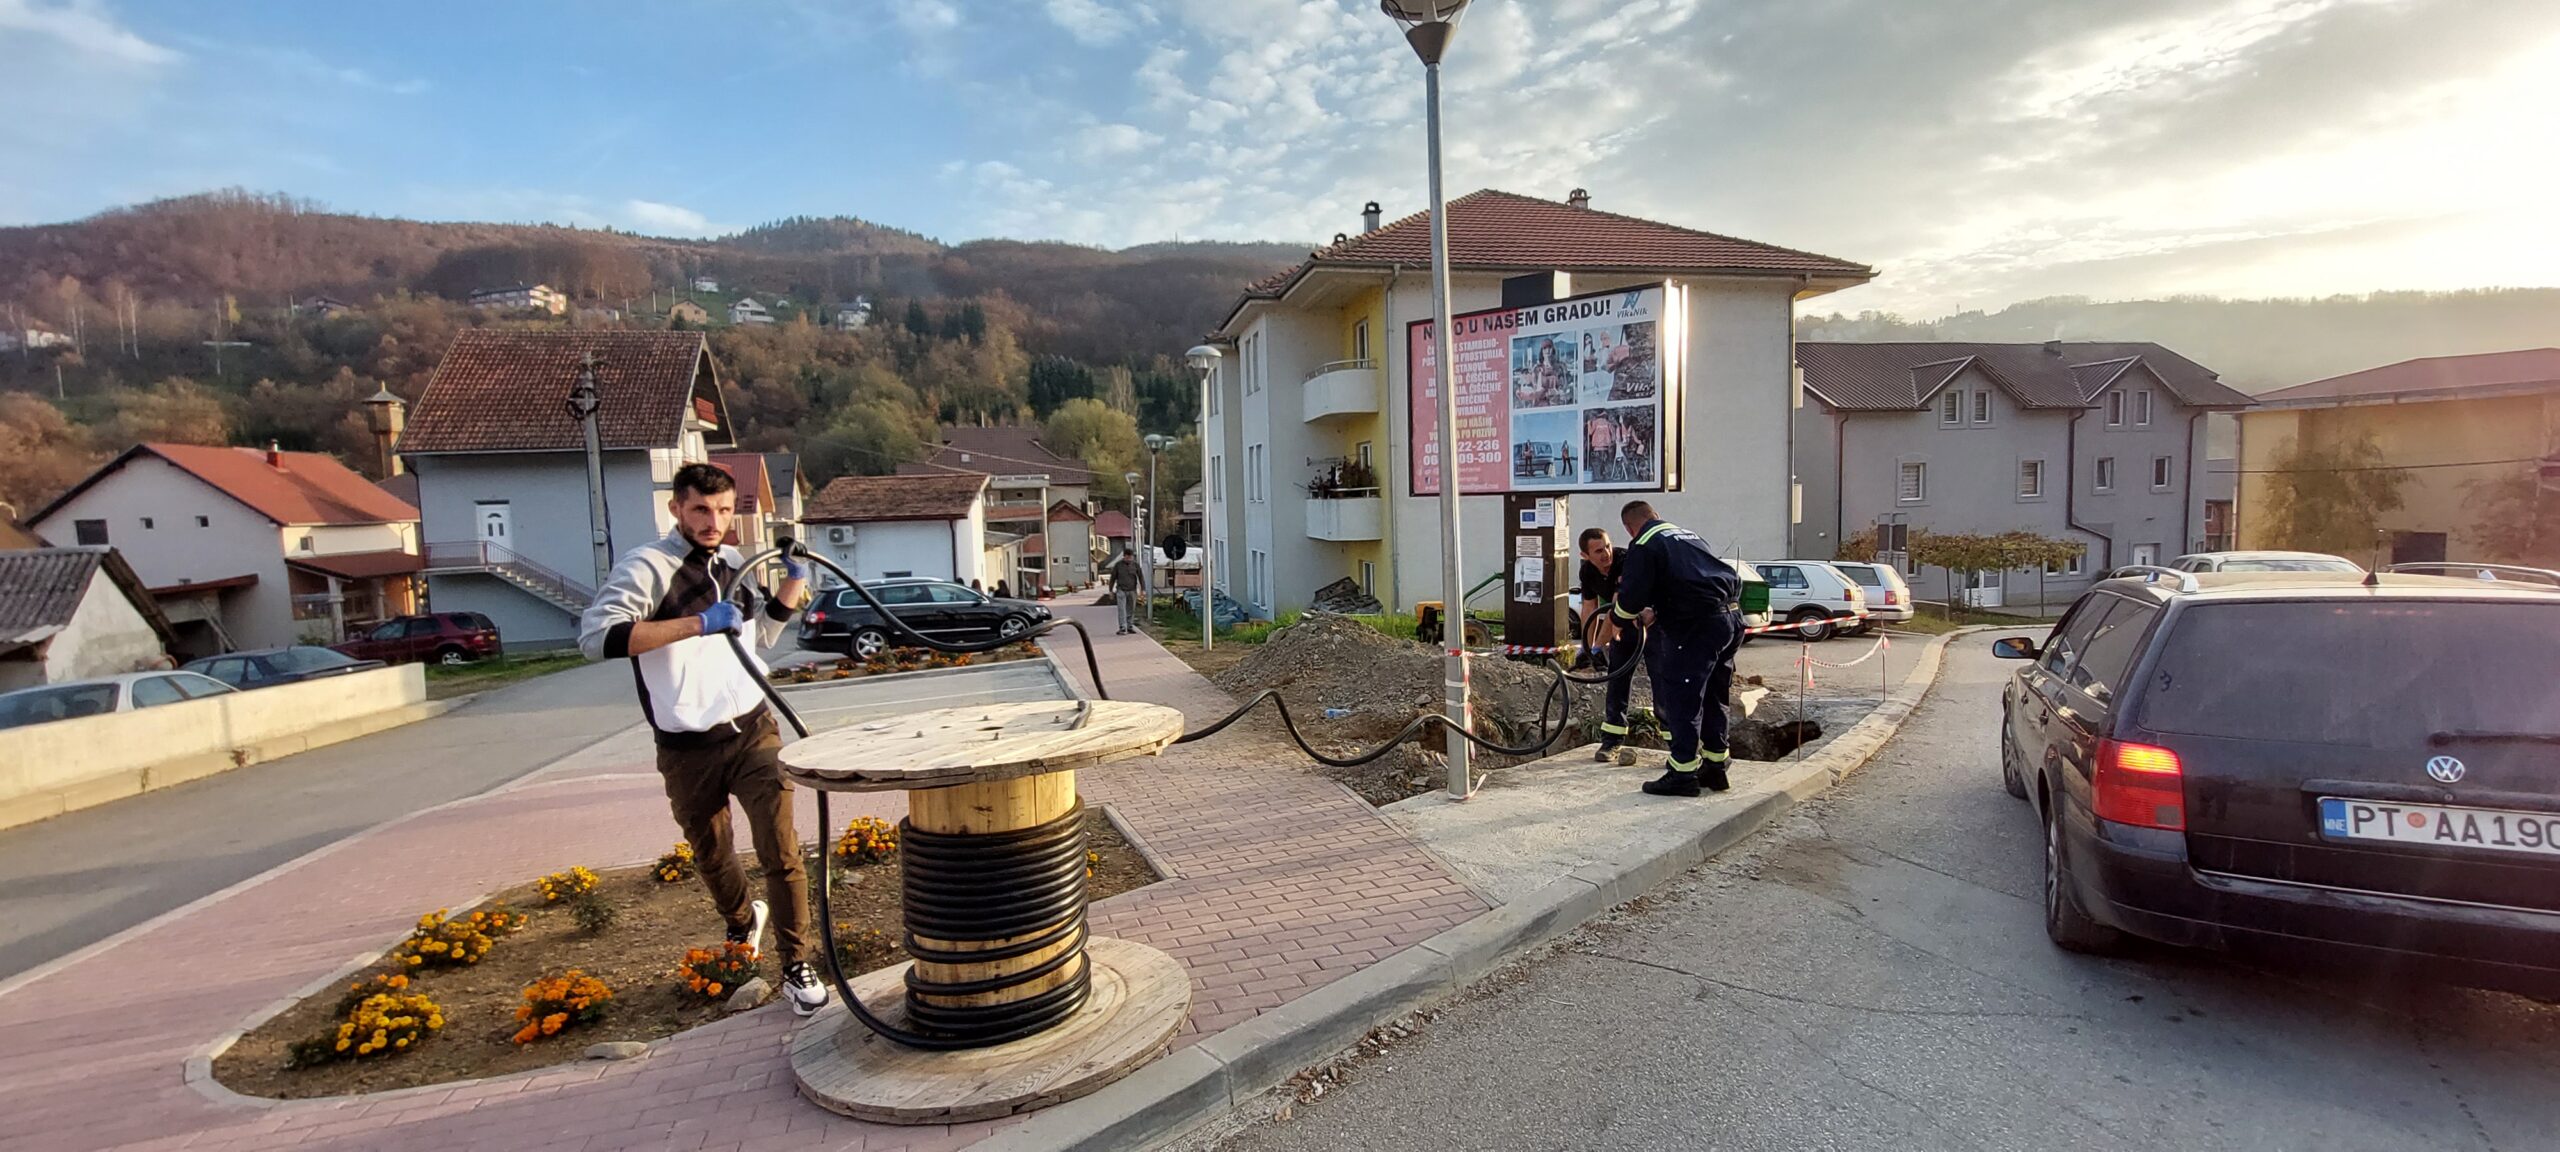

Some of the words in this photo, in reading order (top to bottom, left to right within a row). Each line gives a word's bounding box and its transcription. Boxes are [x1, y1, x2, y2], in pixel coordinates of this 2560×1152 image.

[1468, 319, 1479, 334] U
[1543, 299, 1612, 324] GRADU!
[2323, 818, 2347, 832] MNE
[2352, 805, 2401, 836] PT
